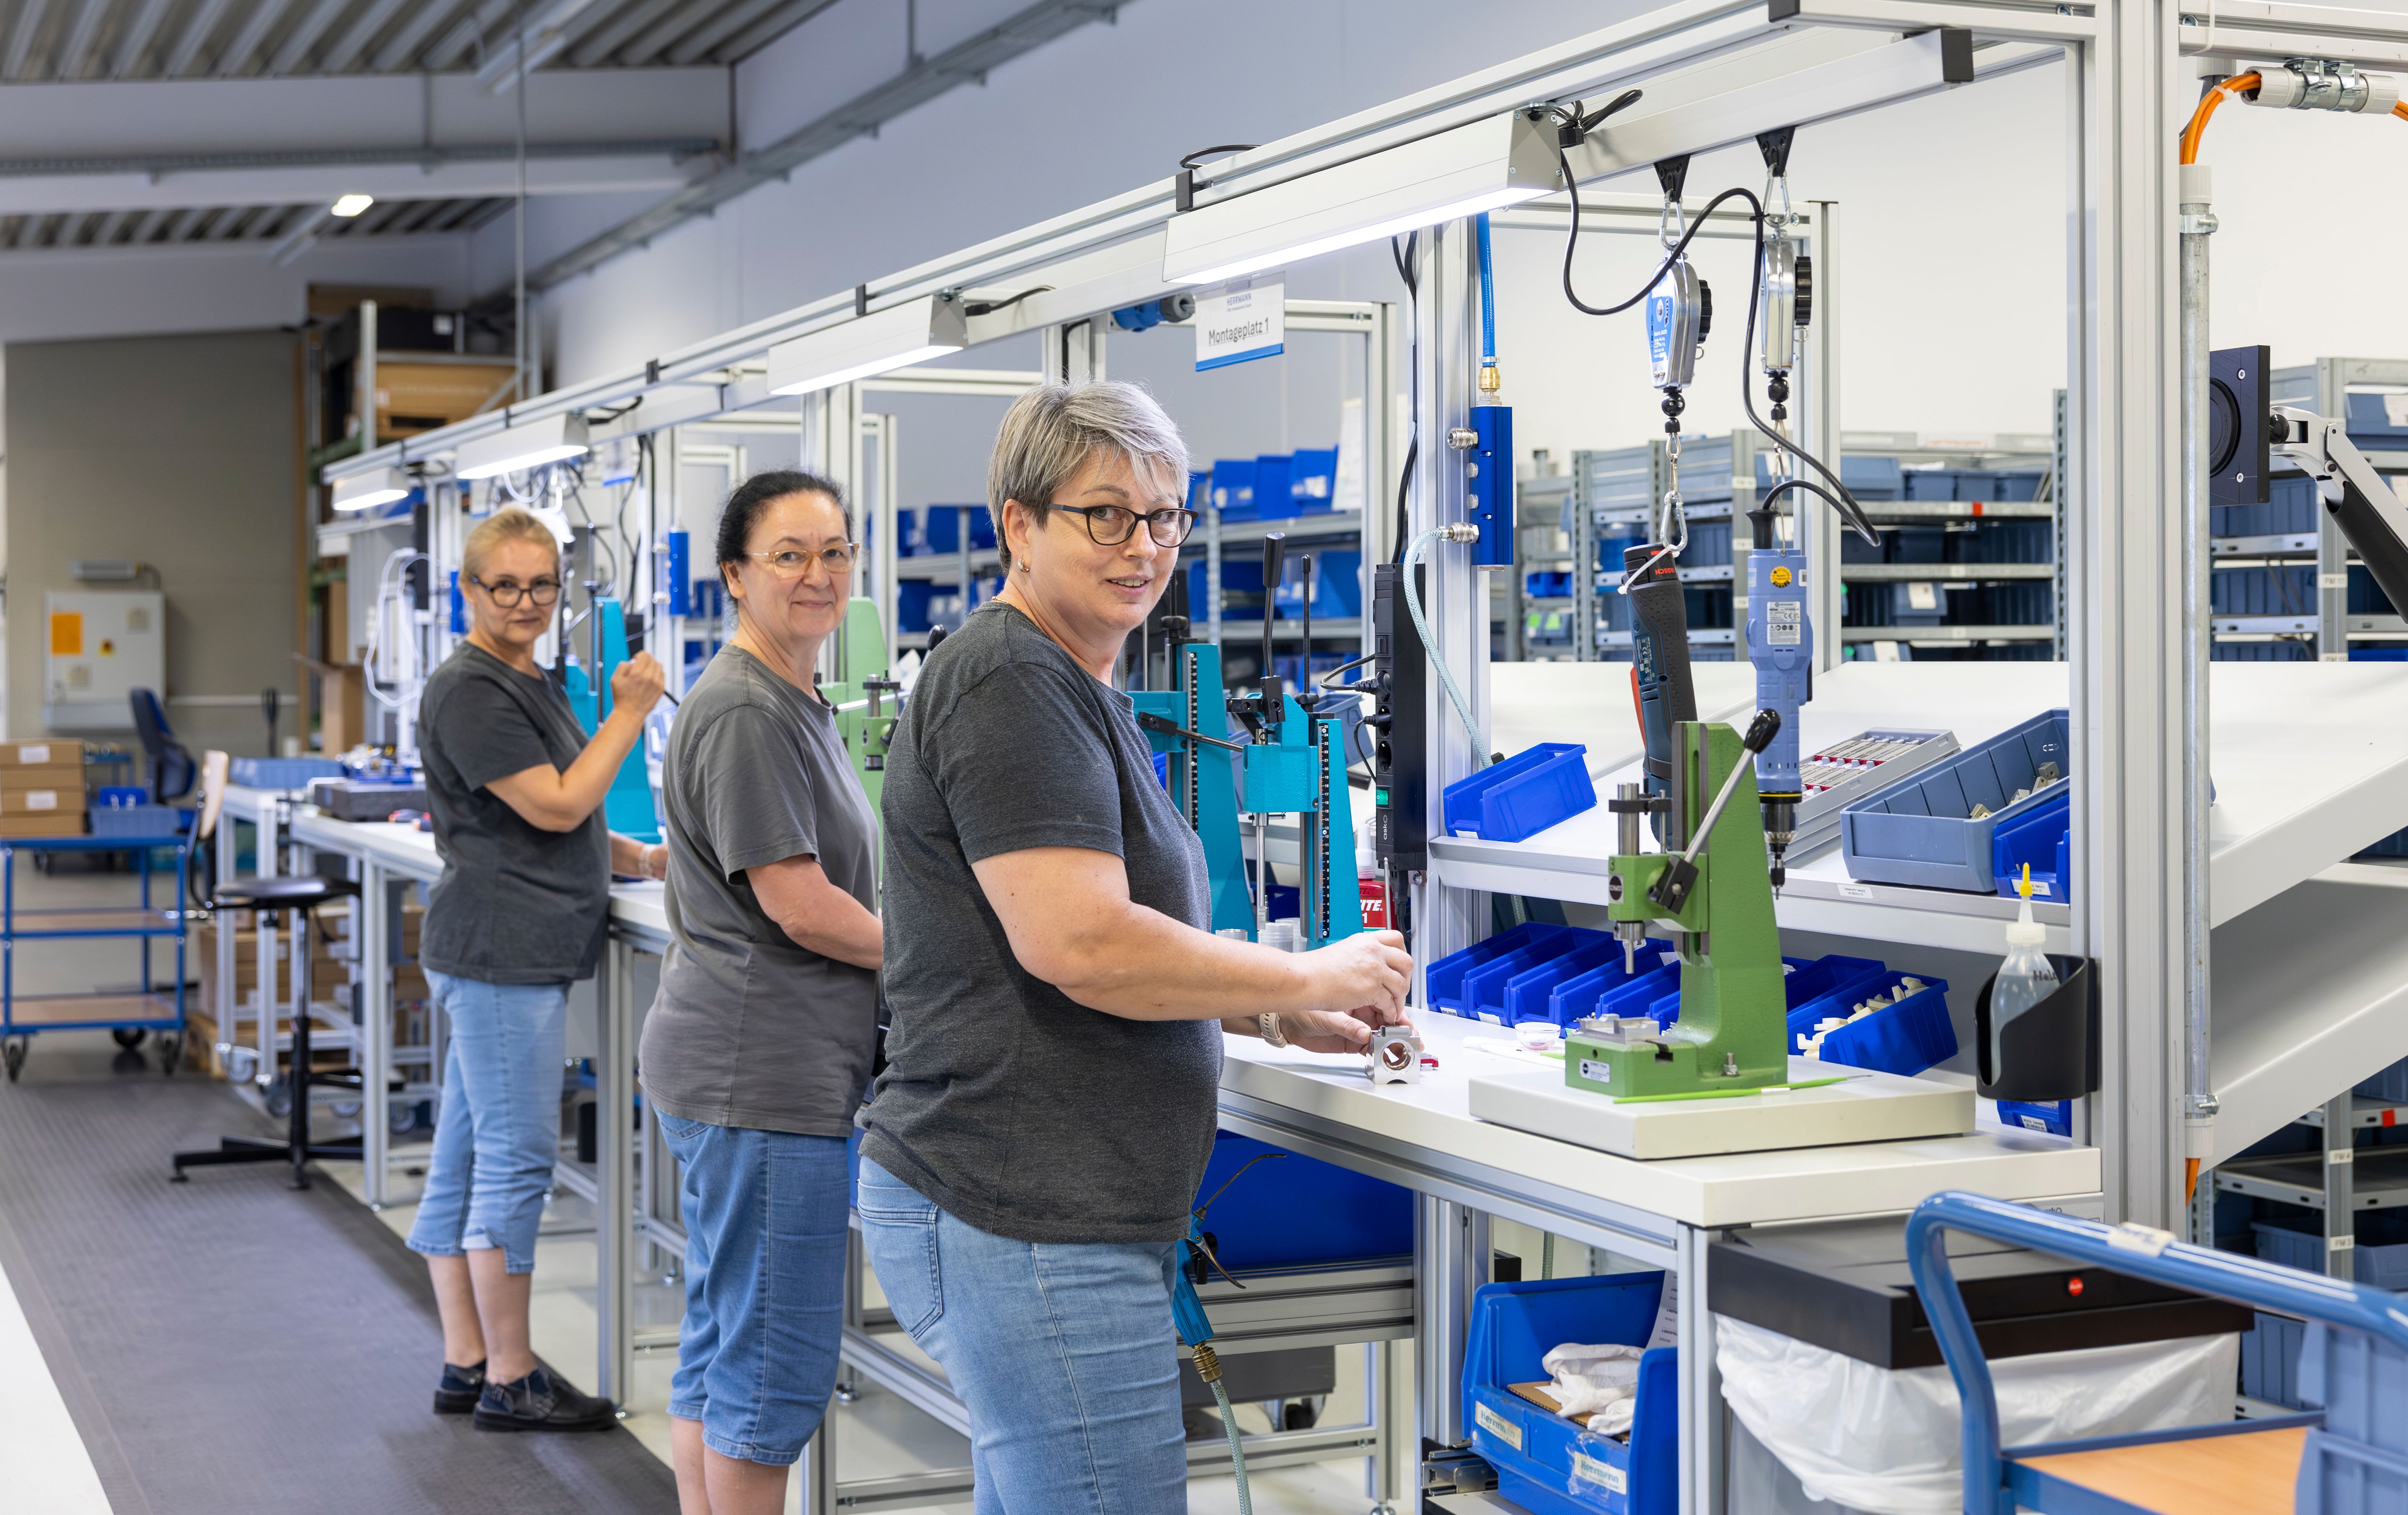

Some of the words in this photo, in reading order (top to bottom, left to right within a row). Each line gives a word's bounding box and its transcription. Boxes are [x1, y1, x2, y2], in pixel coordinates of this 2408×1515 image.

[1208, 320, 1263, 343] Montageplatz
[1265, 317, 1268, 332] 1
[1655, 567, 1675, 576] BOSCH
